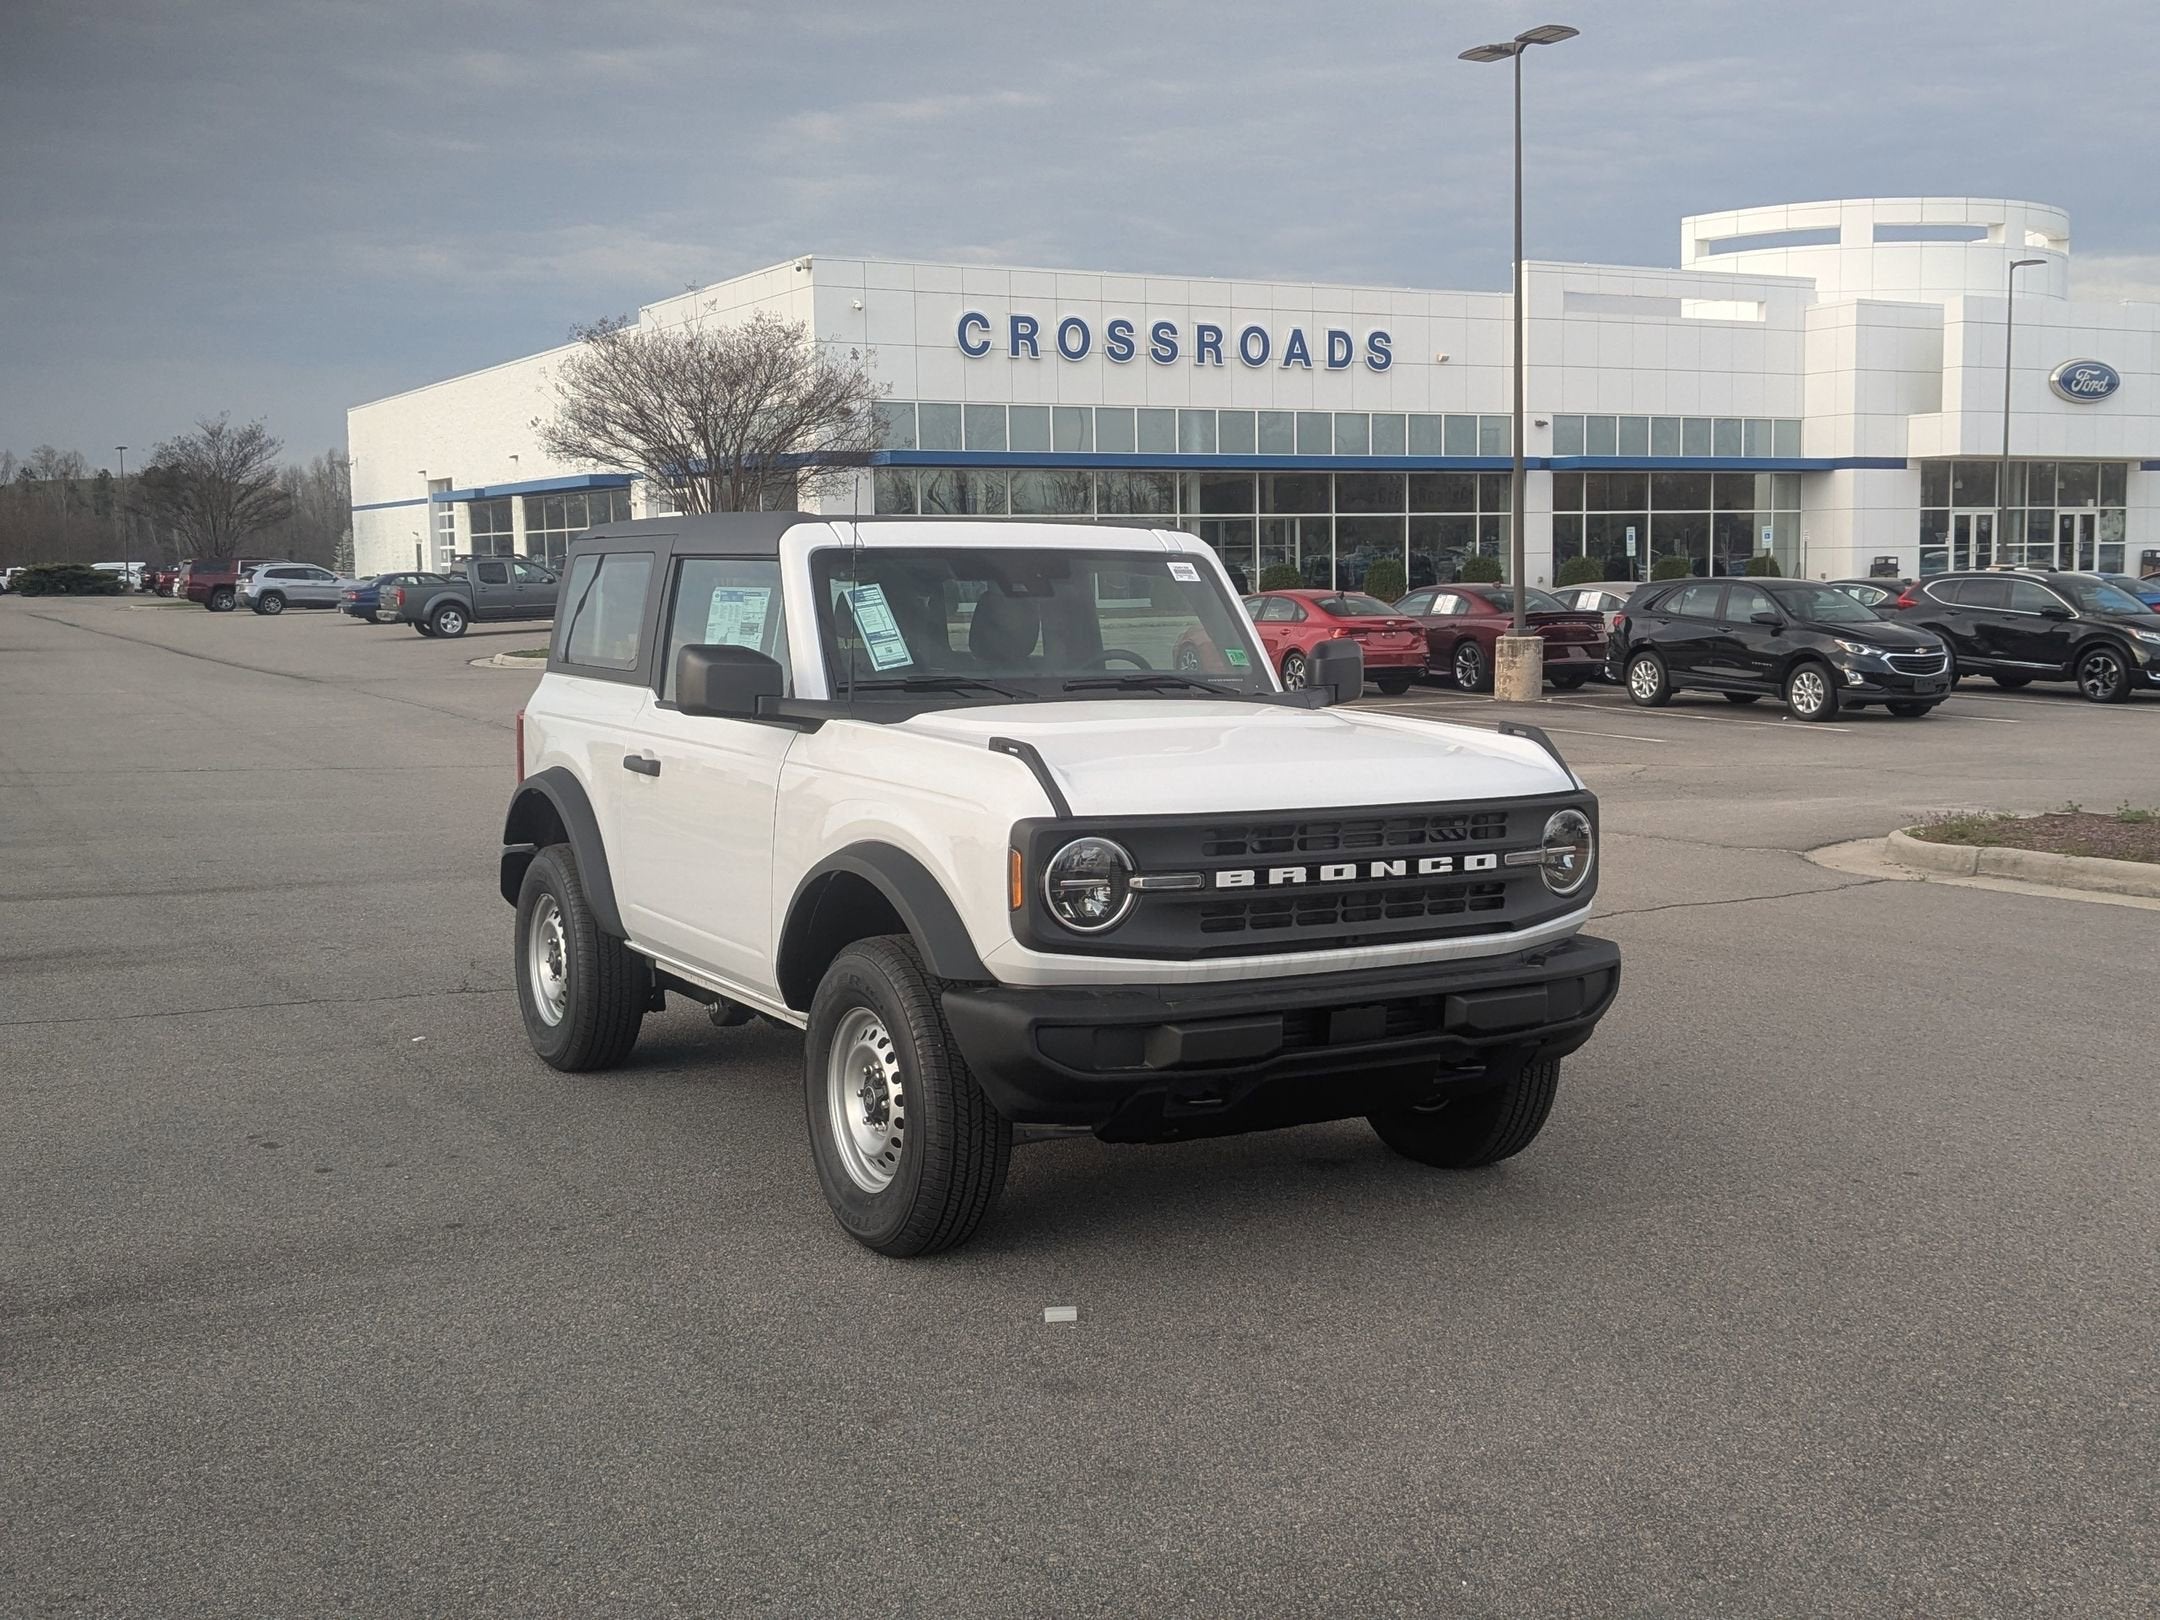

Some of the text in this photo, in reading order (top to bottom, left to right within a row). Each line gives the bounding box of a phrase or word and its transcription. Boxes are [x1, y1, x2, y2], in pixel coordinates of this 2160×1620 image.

[957, 310, 1394, 373] CROSSROADS
[2071, 368, 2110, 393] Ford
[1215, 853, 1498, 888] BRONCO
